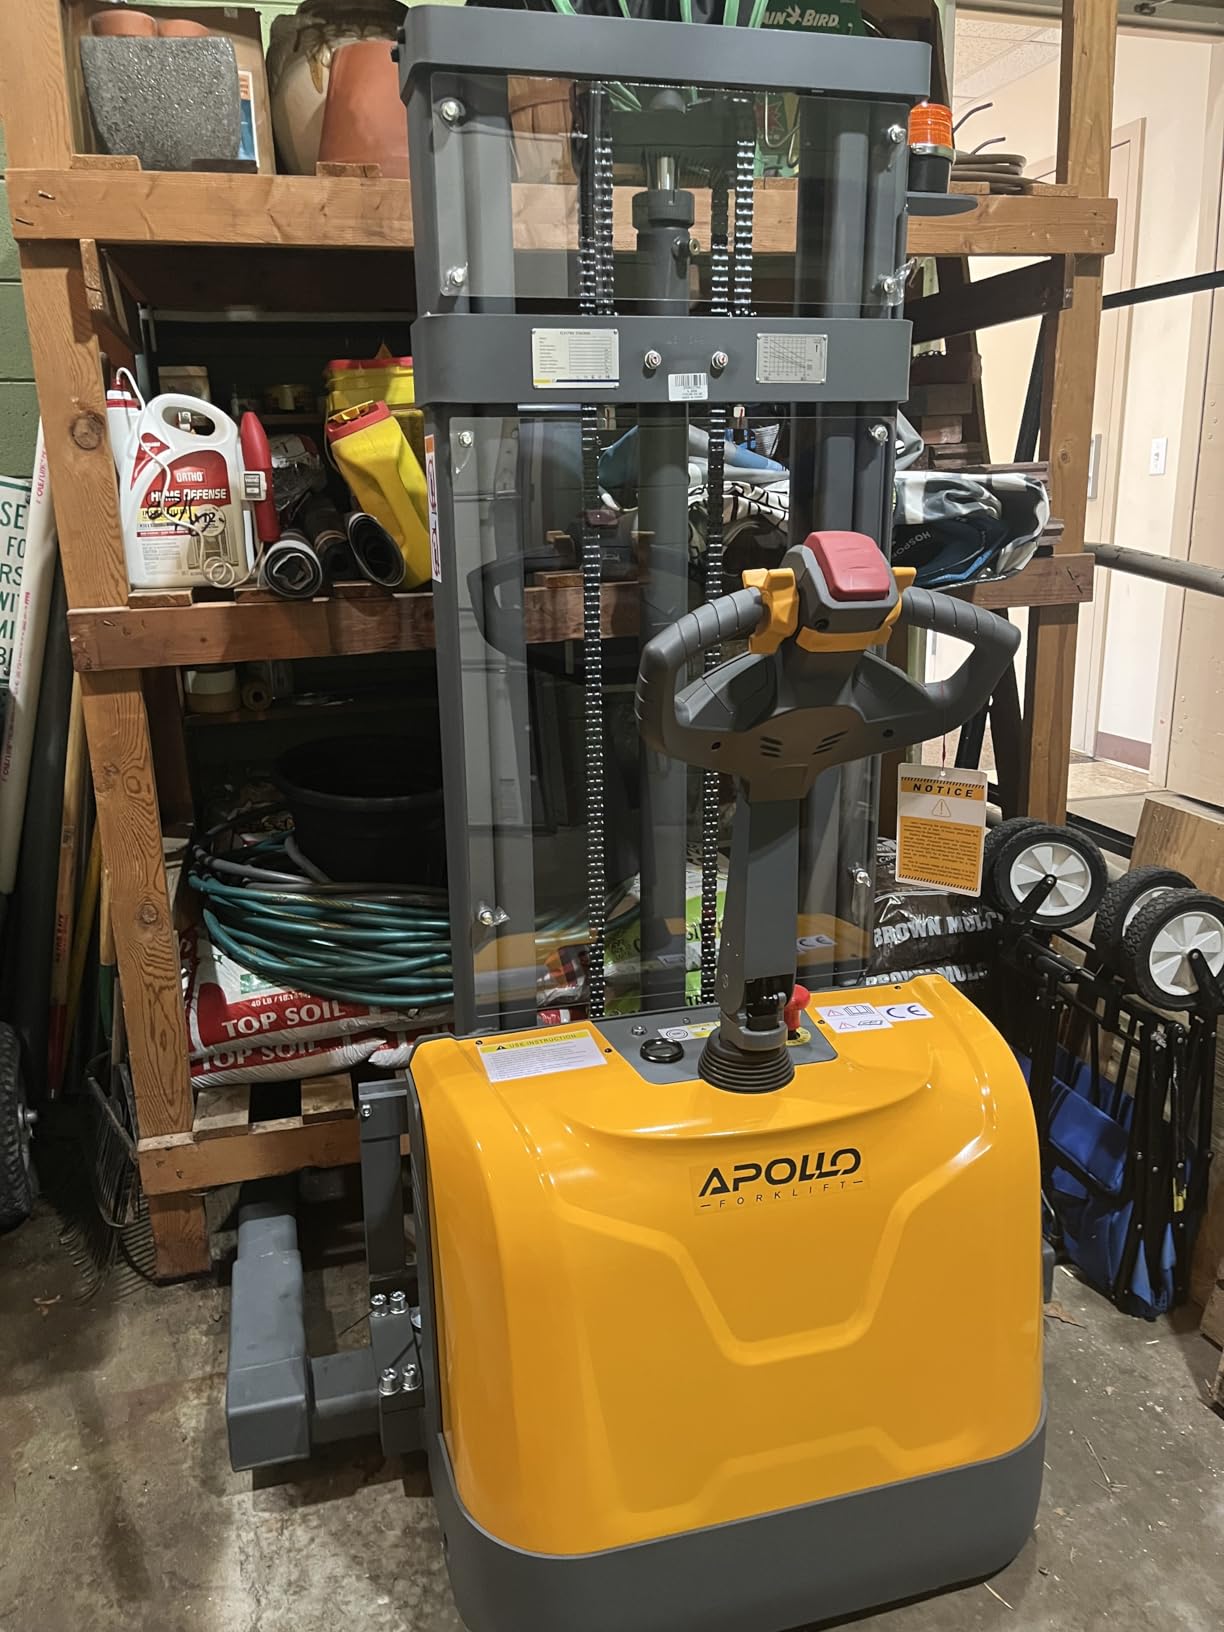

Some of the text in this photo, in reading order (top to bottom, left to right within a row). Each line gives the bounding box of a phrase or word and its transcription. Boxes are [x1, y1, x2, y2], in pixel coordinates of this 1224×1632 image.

[802, 9, 840, 27] BIRD
[176, 472, 204, 483] ORTHO
[184, 488, 227, 501] DEFENSE
[913, 783, 974, 798] NOTICE
[873, 915, 942, 948] BROWN
[222, 1000, 347, 1038] TOP SOIL
[885, 1005, 927, 1019] CE
[698, 1147, 862, 1198] APOLLO
[719, 1181, 847, 1208] FORKLIFT
